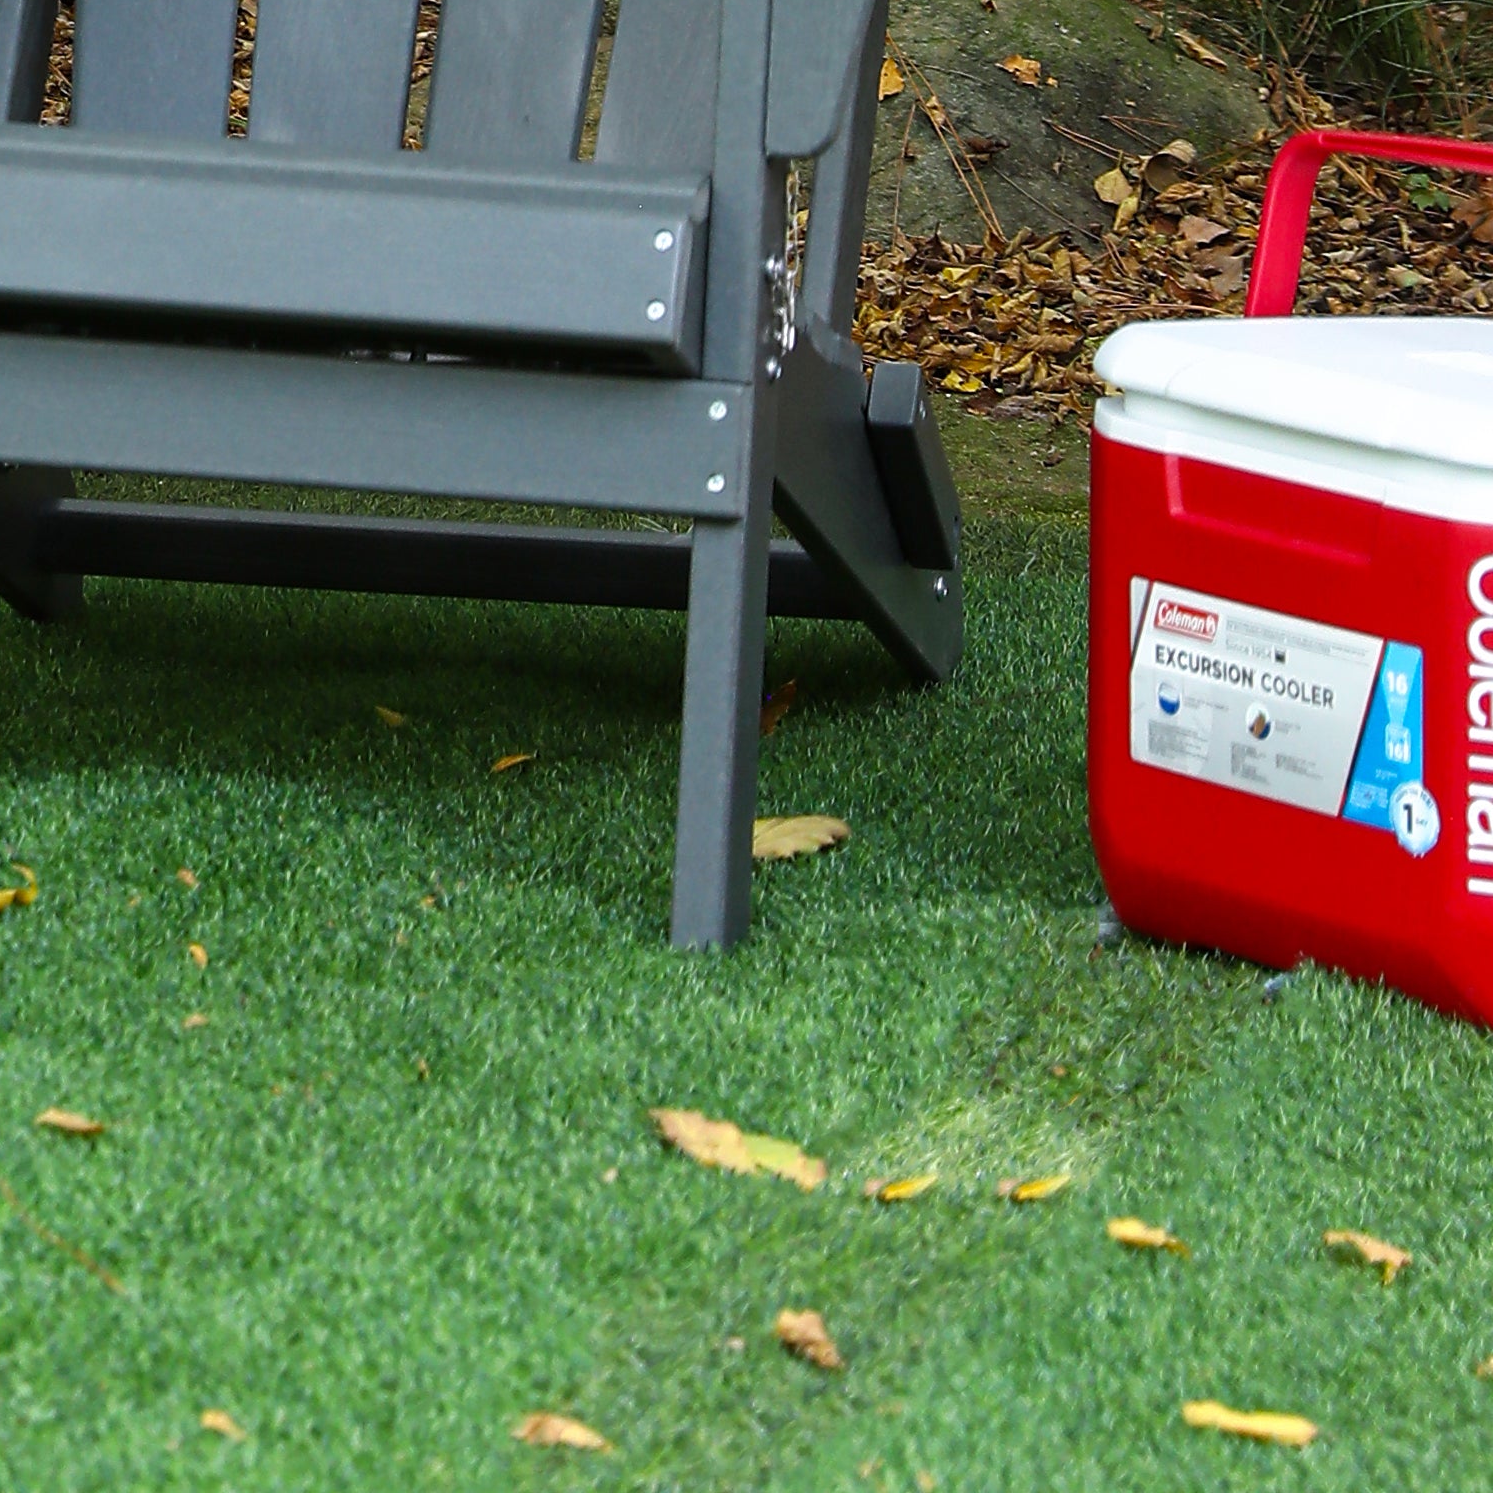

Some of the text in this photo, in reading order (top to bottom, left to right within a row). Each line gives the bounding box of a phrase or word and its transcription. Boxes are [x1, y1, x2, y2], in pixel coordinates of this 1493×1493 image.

[1158, 601, 1206, 634] Coleman
[1155, 643, 1335, 710] EXCURSION COOLER
[1386, 670, 1409, 696] 16
[1402, 802, 1413, 835] 1
